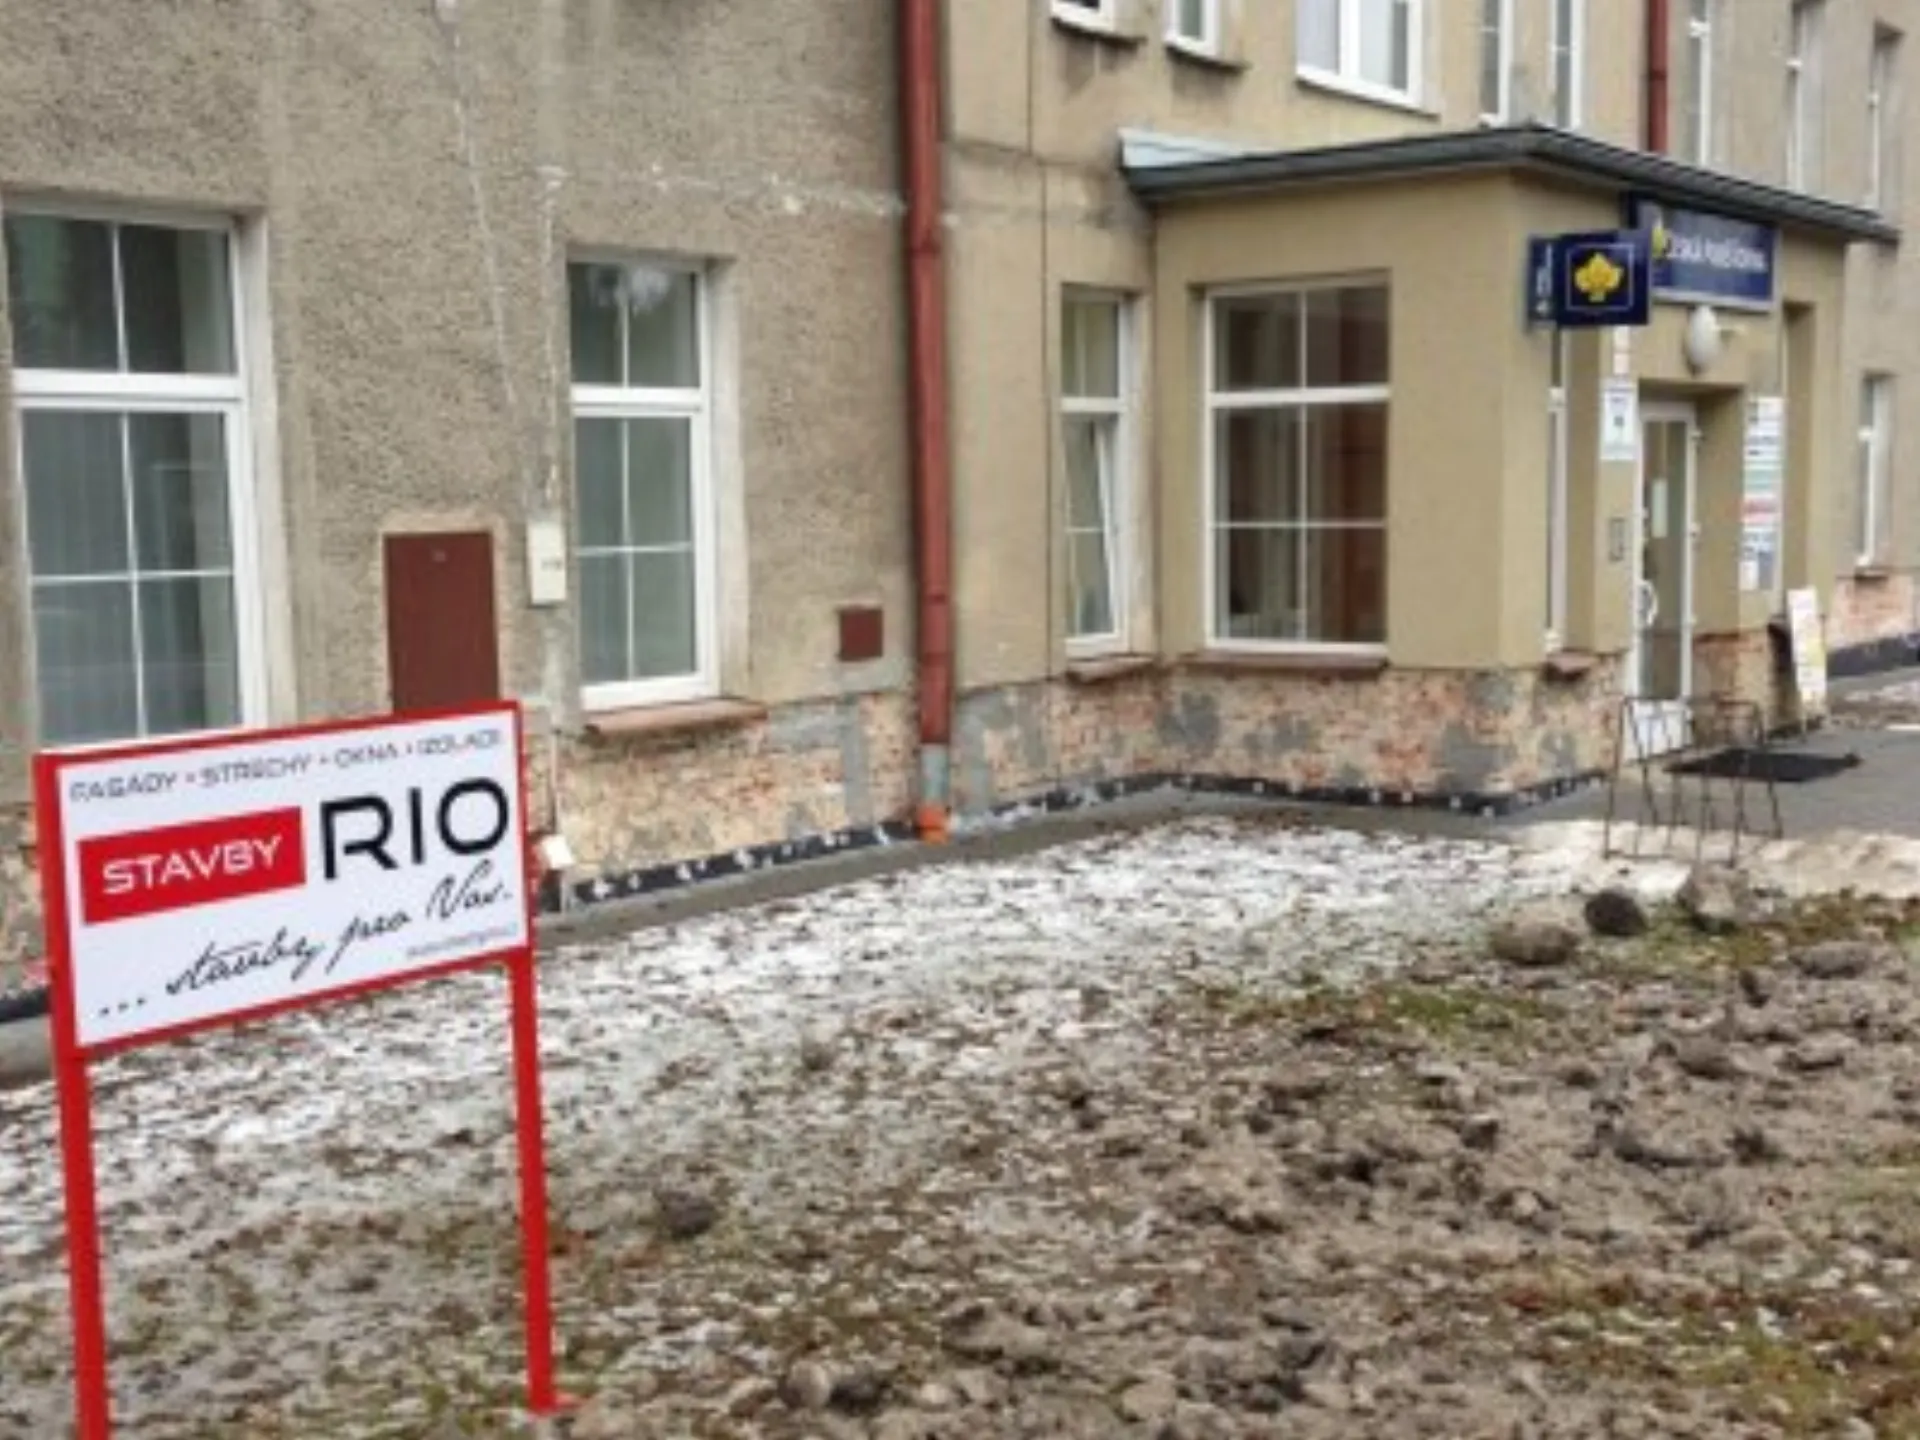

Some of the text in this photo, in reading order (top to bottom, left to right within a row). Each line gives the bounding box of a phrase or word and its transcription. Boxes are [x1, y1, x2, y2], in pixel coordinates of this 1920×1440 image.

[102, 777, 510, 896] STAVBY RIO
[325, 910, 411, 974] pro
